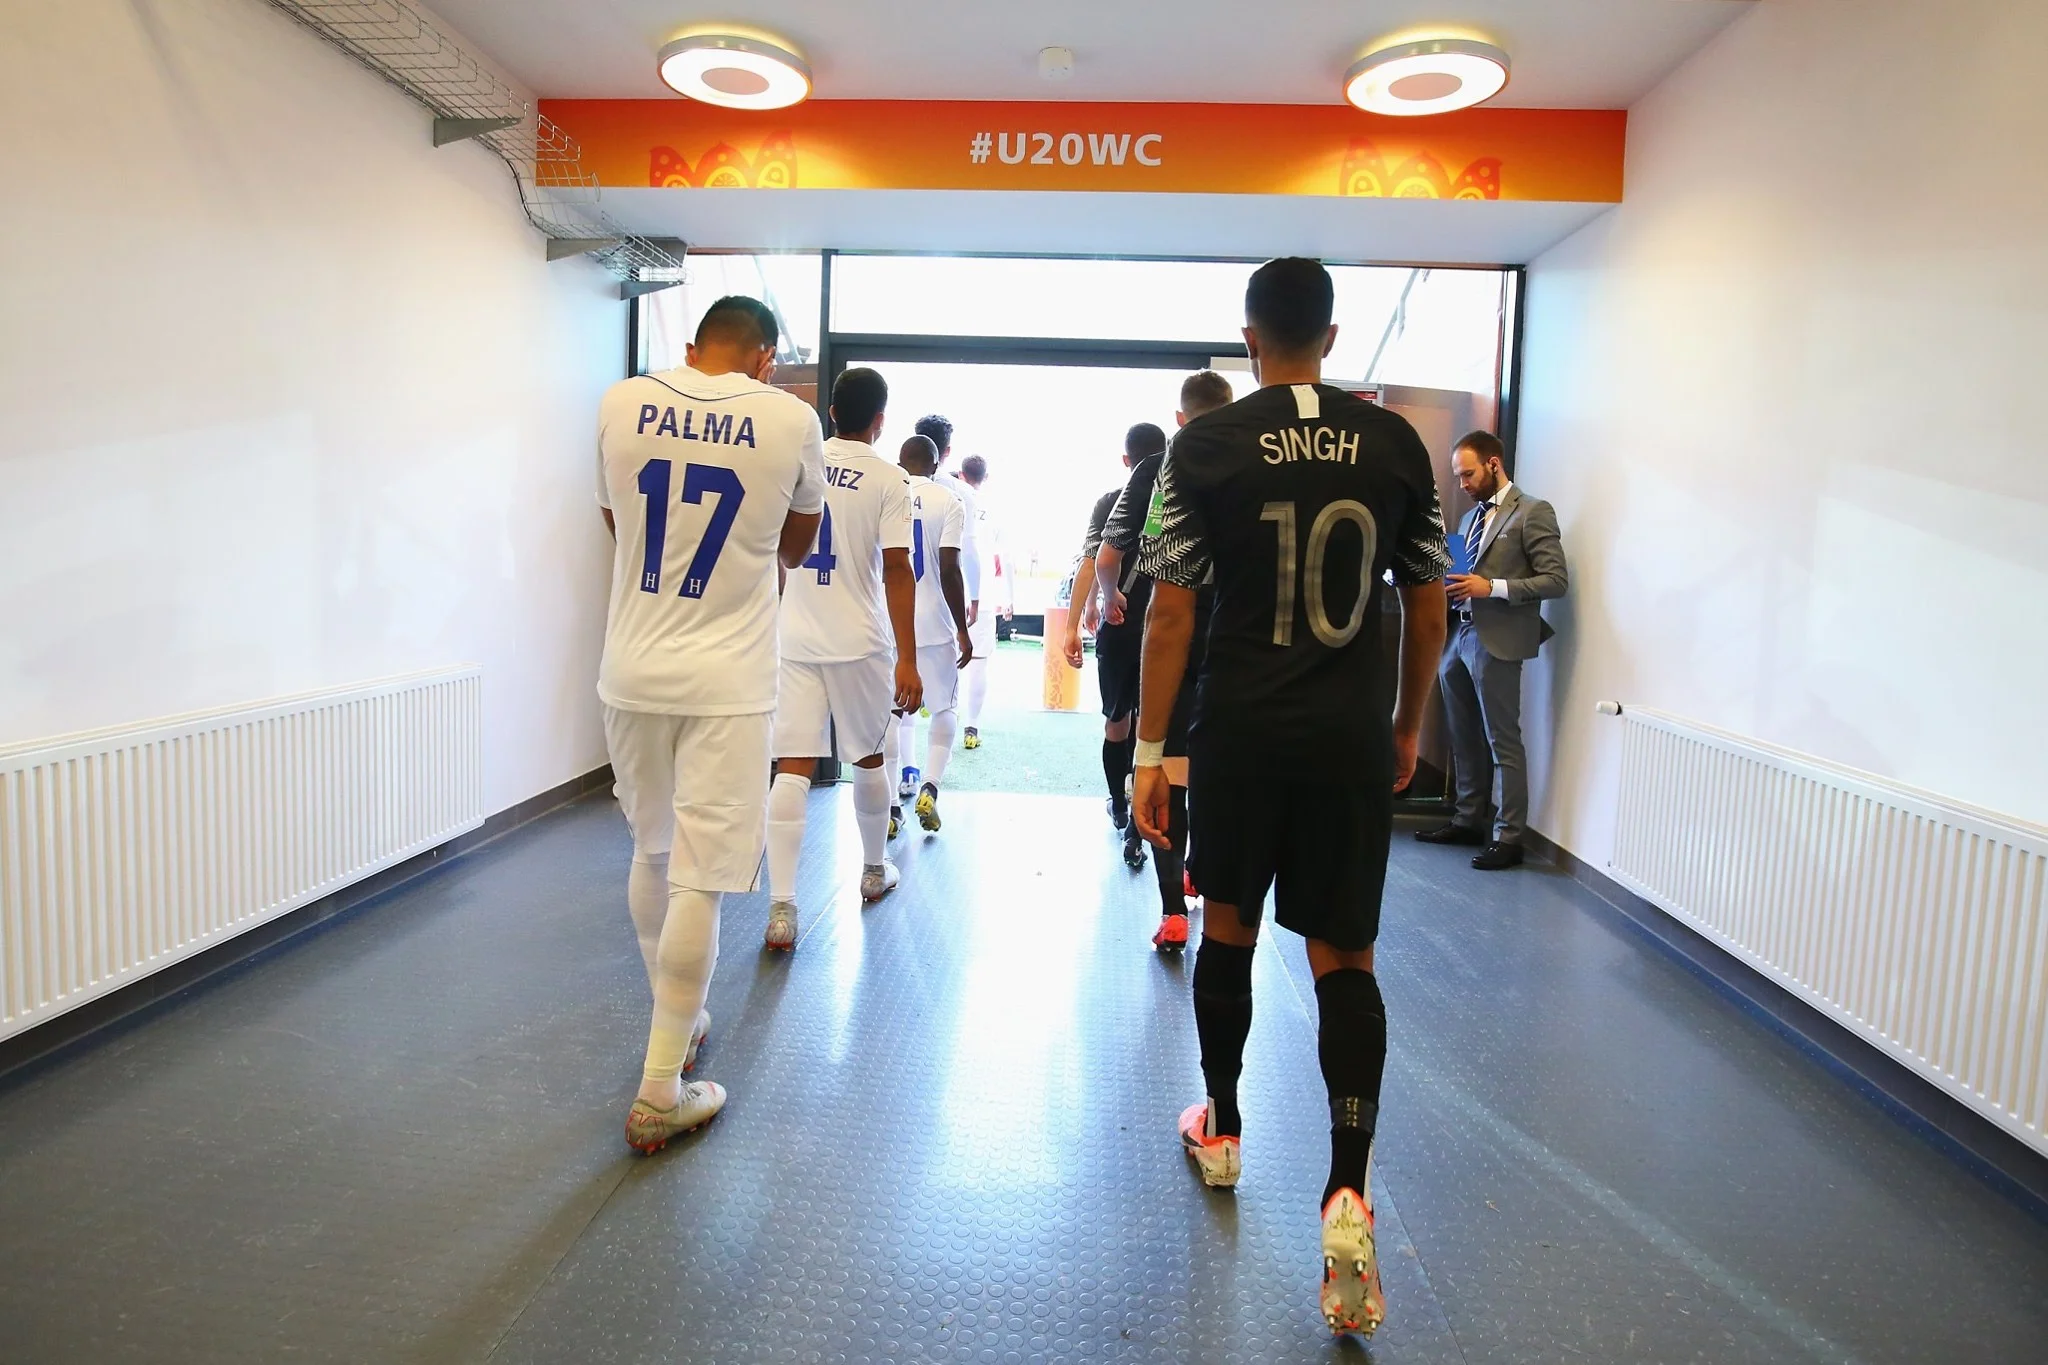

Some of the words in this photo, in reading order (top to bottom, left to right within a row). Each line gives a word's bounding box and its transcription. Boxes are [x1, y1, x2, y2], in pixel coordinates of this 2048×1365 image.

[969, 132, 1162, 166] #U20WC
[637, 404, 756, 449] PALMA
[1259, 426, 1360, 465] SINGH
[637, 458, 746, 600] 17
[1259, 499, 1377, 649] 10
